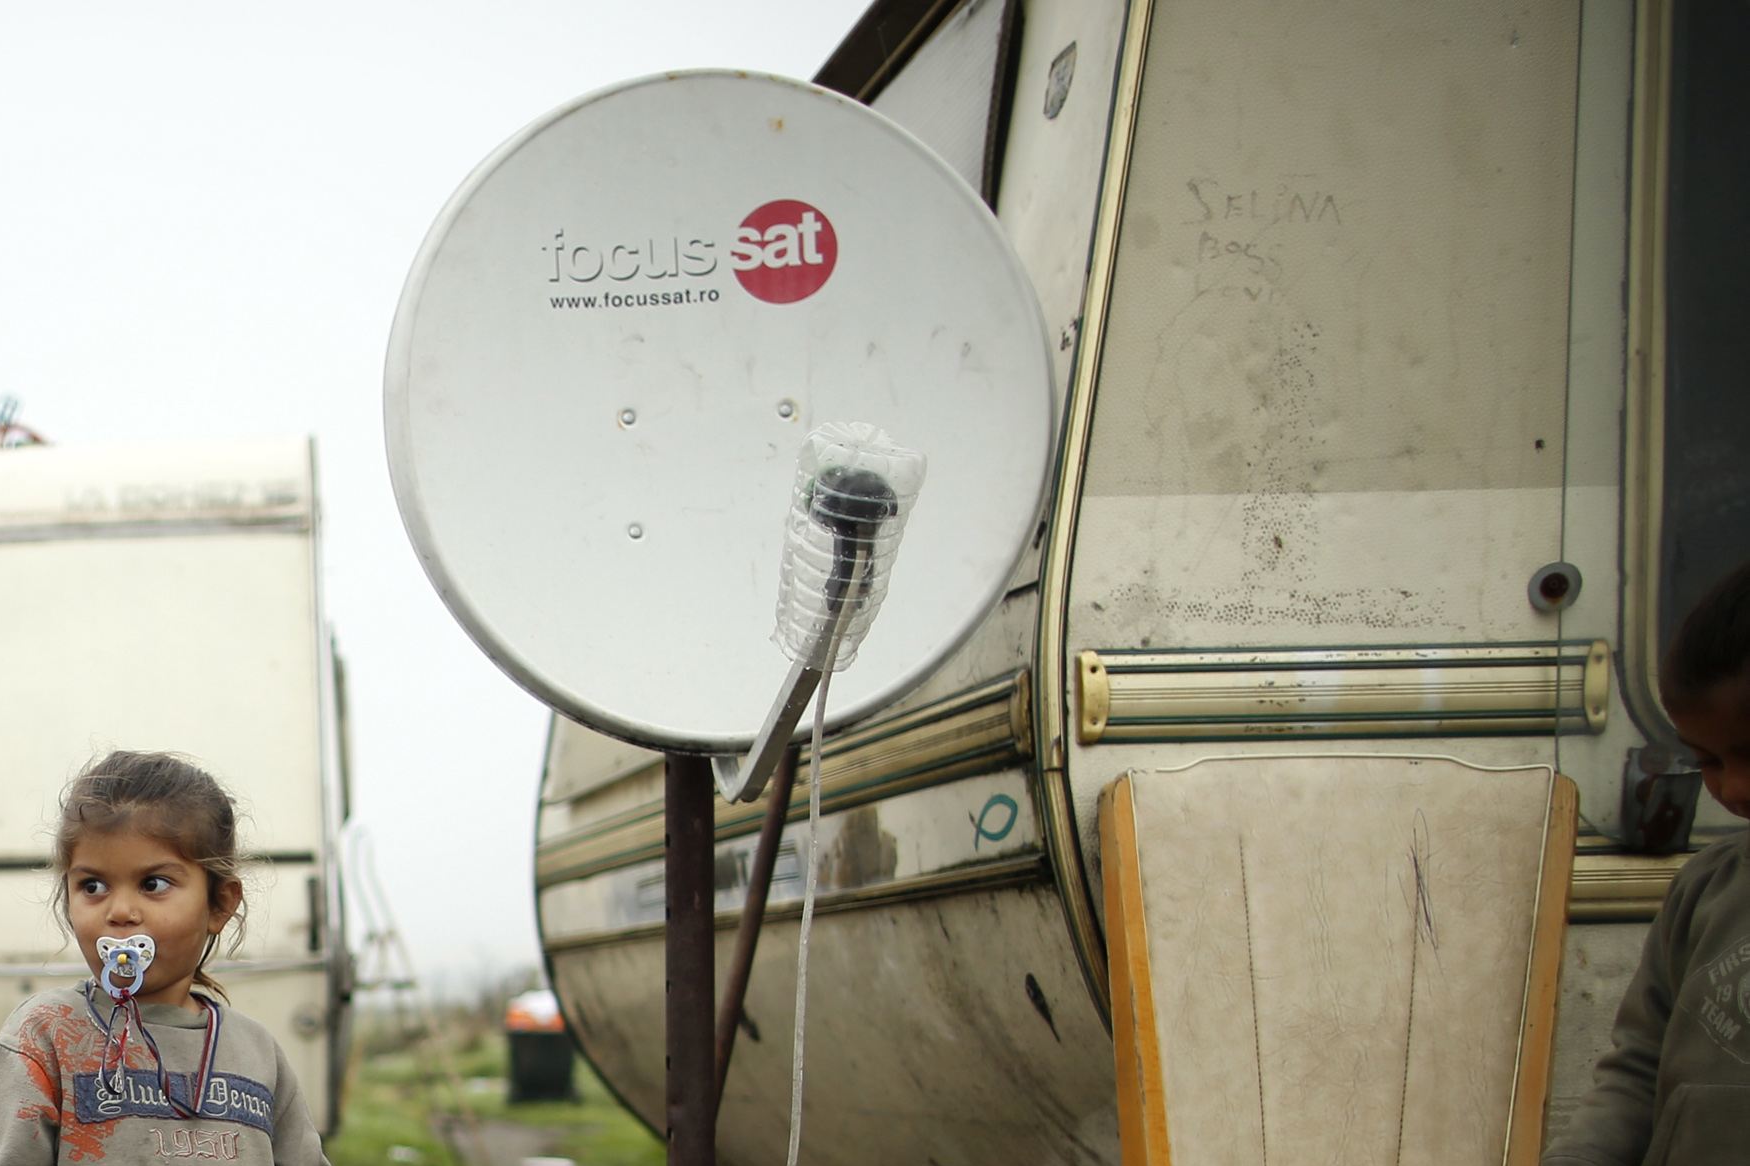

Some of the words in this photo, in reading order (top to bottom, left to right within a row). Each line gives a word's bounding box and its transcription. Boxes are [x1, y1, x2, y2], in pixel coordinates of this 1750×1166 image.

[542, 229, 718, 283] focus
[730, 211, 823, 271] sat
[550, 289, 720, 310] www.focussat.ro
[1700, 995, 1742, 1041] TEAM
[148, 1127, 240, 1161] 1950
